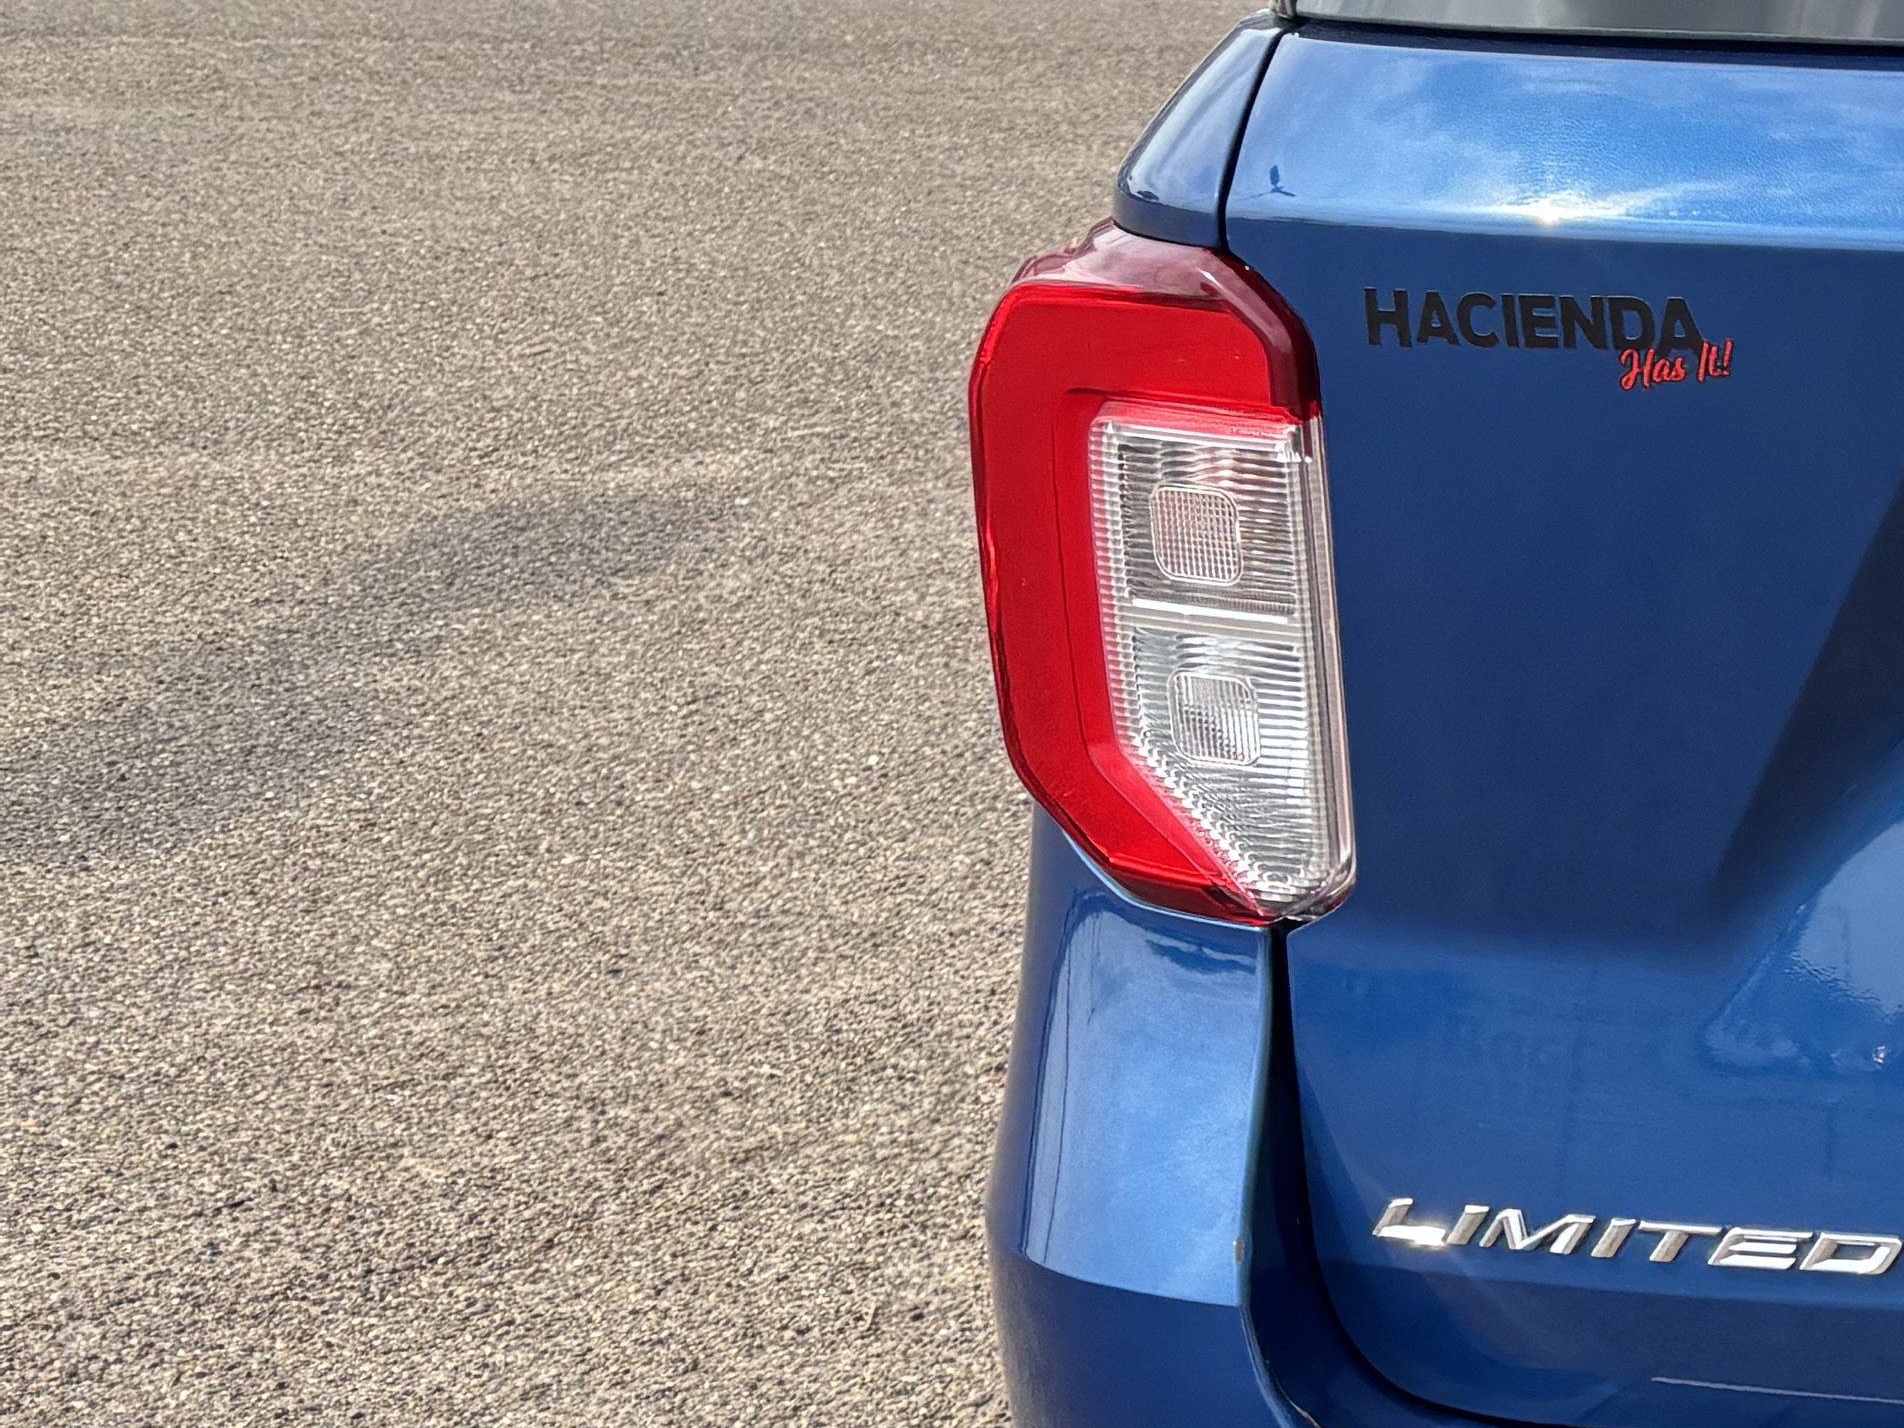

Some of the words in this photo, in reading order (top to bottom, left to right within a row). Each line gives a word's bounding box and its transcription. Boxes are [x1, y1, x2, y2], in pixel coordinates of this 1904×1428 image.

[1363, 286, 1704, 357] HACIENDA
[1619, 346, 1687, 391] Has
[1696, 338, 1734, 383] It!
[1371, 1197, 1904, 1276] LIMITED
